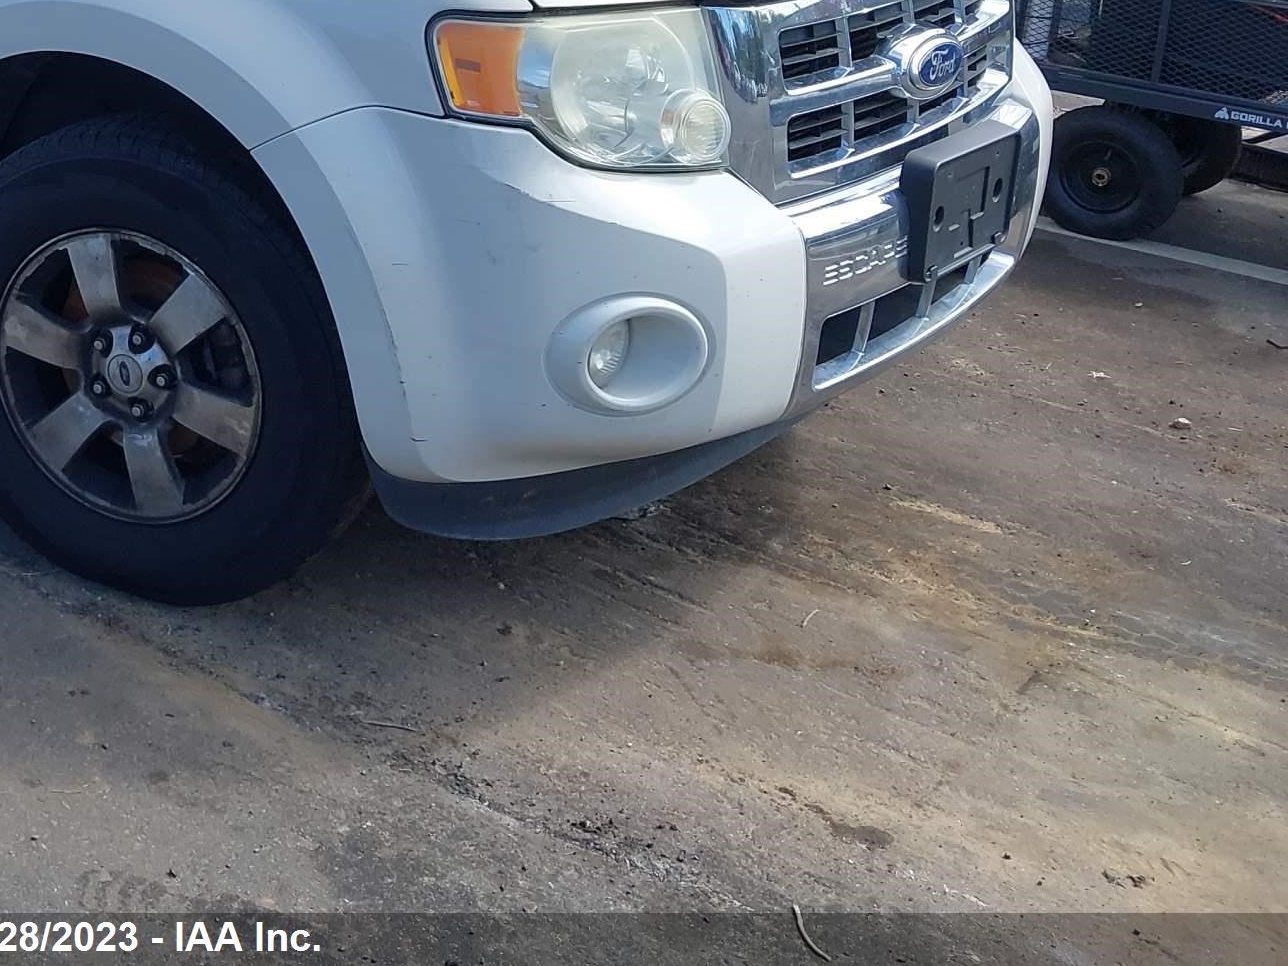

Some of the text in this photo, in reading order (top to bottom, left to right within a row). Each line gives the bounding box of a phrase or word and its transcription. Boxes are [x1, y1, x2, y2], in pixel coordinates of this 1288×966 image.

[929, 48, 956, 81] Ford
[1230, 110, 1283, 129] GORILLA
[822, 235, 908, 287] ESCAPE
